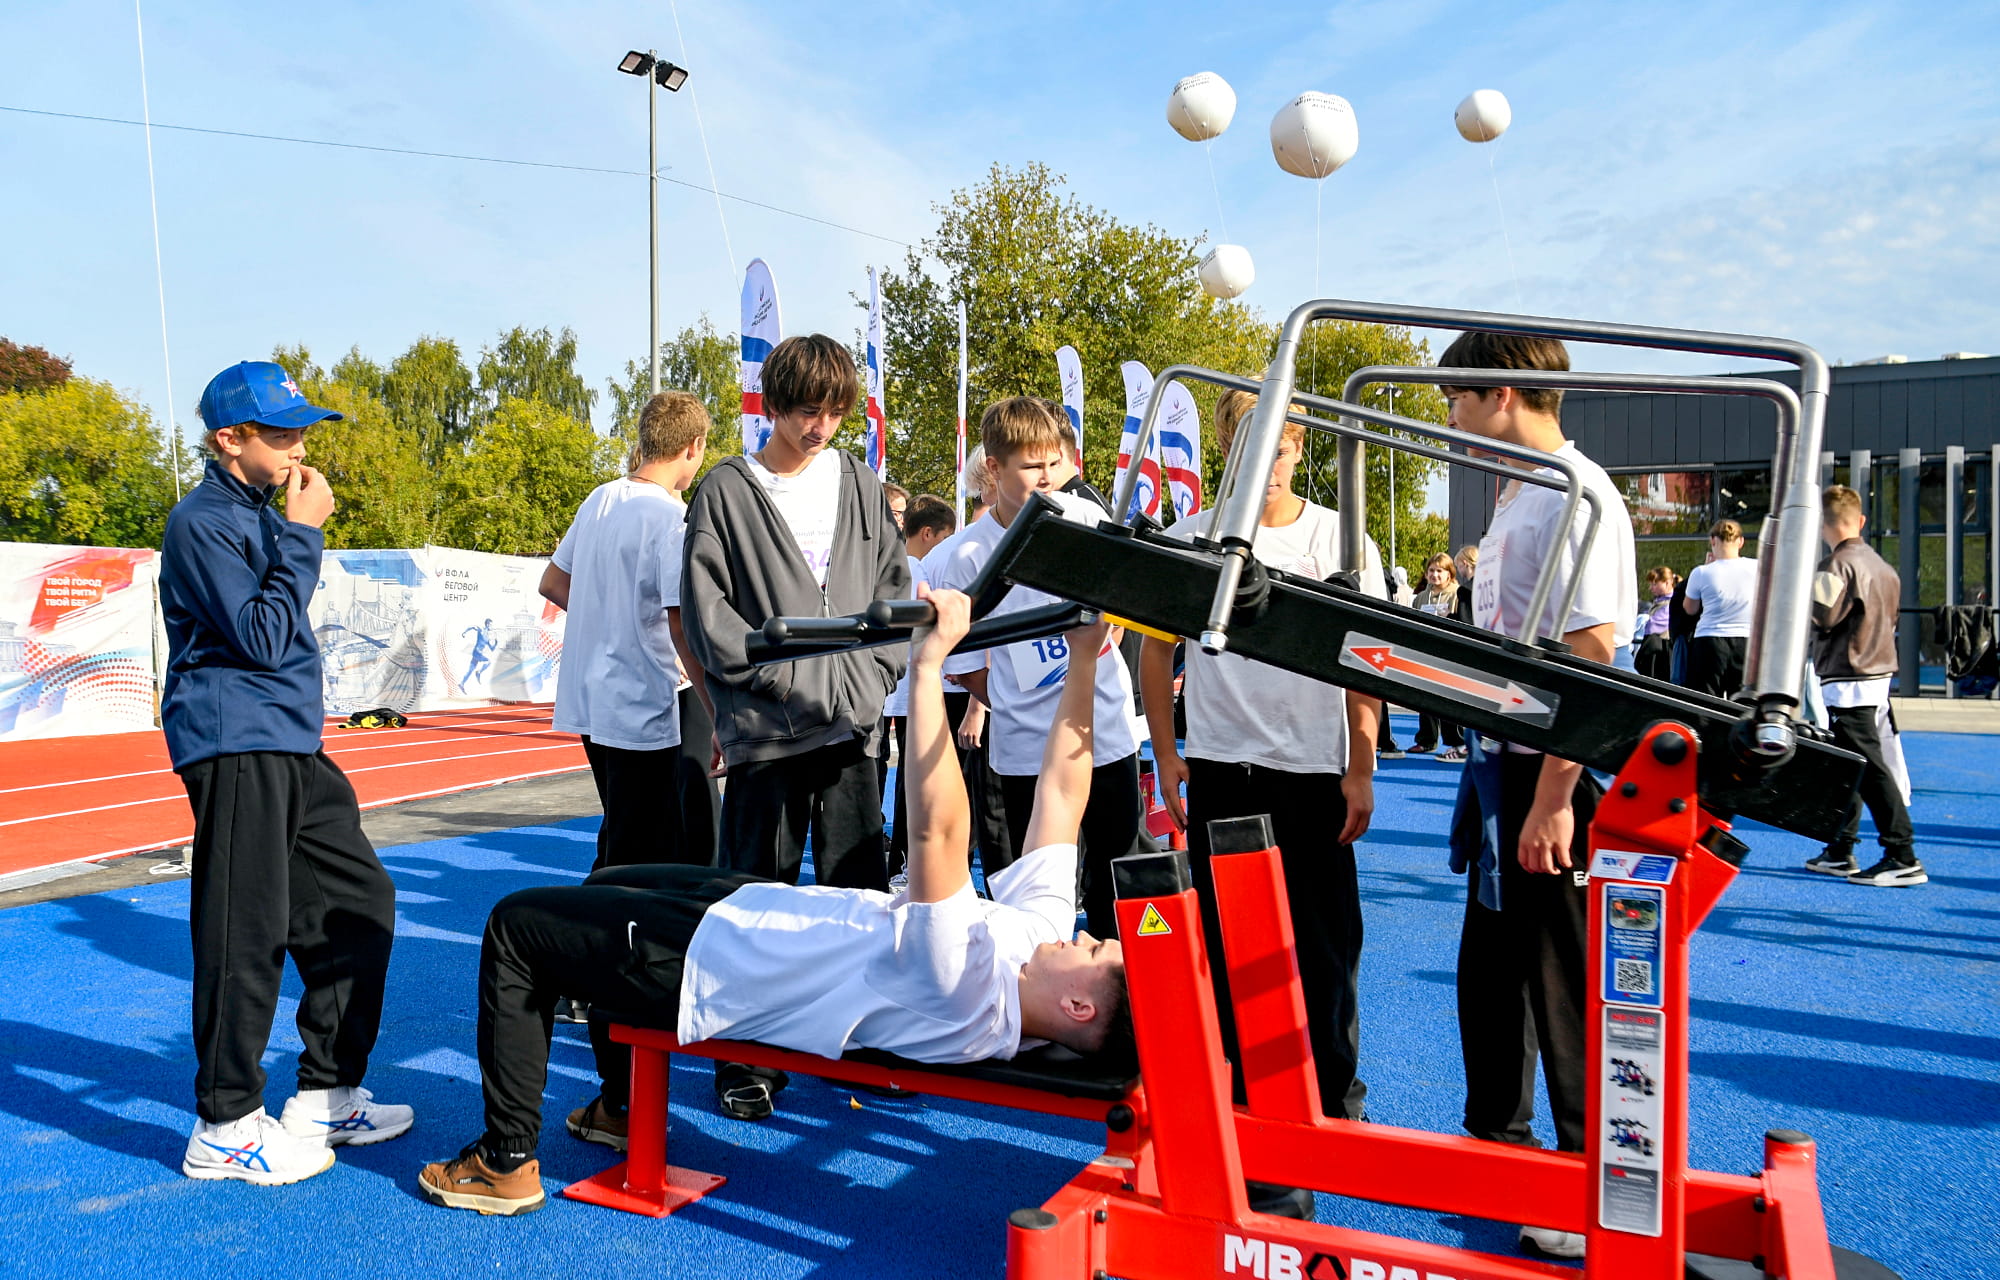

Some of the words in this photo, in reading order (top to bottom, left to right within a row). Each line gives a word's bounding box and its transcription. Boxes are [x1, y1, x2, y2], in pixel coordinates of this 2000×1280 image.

[445, 568, 469, 578] ВФЛА
[46, 576, 70, 585] ТВОЙ
[71, 578, 102, 587] ГОРОД
[444, 581, 479, 591] БЕГОВОЙ
[45, 586, 70, 595] ТВОЙ
[71, 588, 97, 596] РИТМ
[44, 597, 70, 606] ТВОЙ
[71, 598, 88, 606] БЕГ
[443, 593, 468, 602] ЦЕНТР
[1031, 636, 1068, 663] 18
[1224, 1233, 1303, 1280] MB
